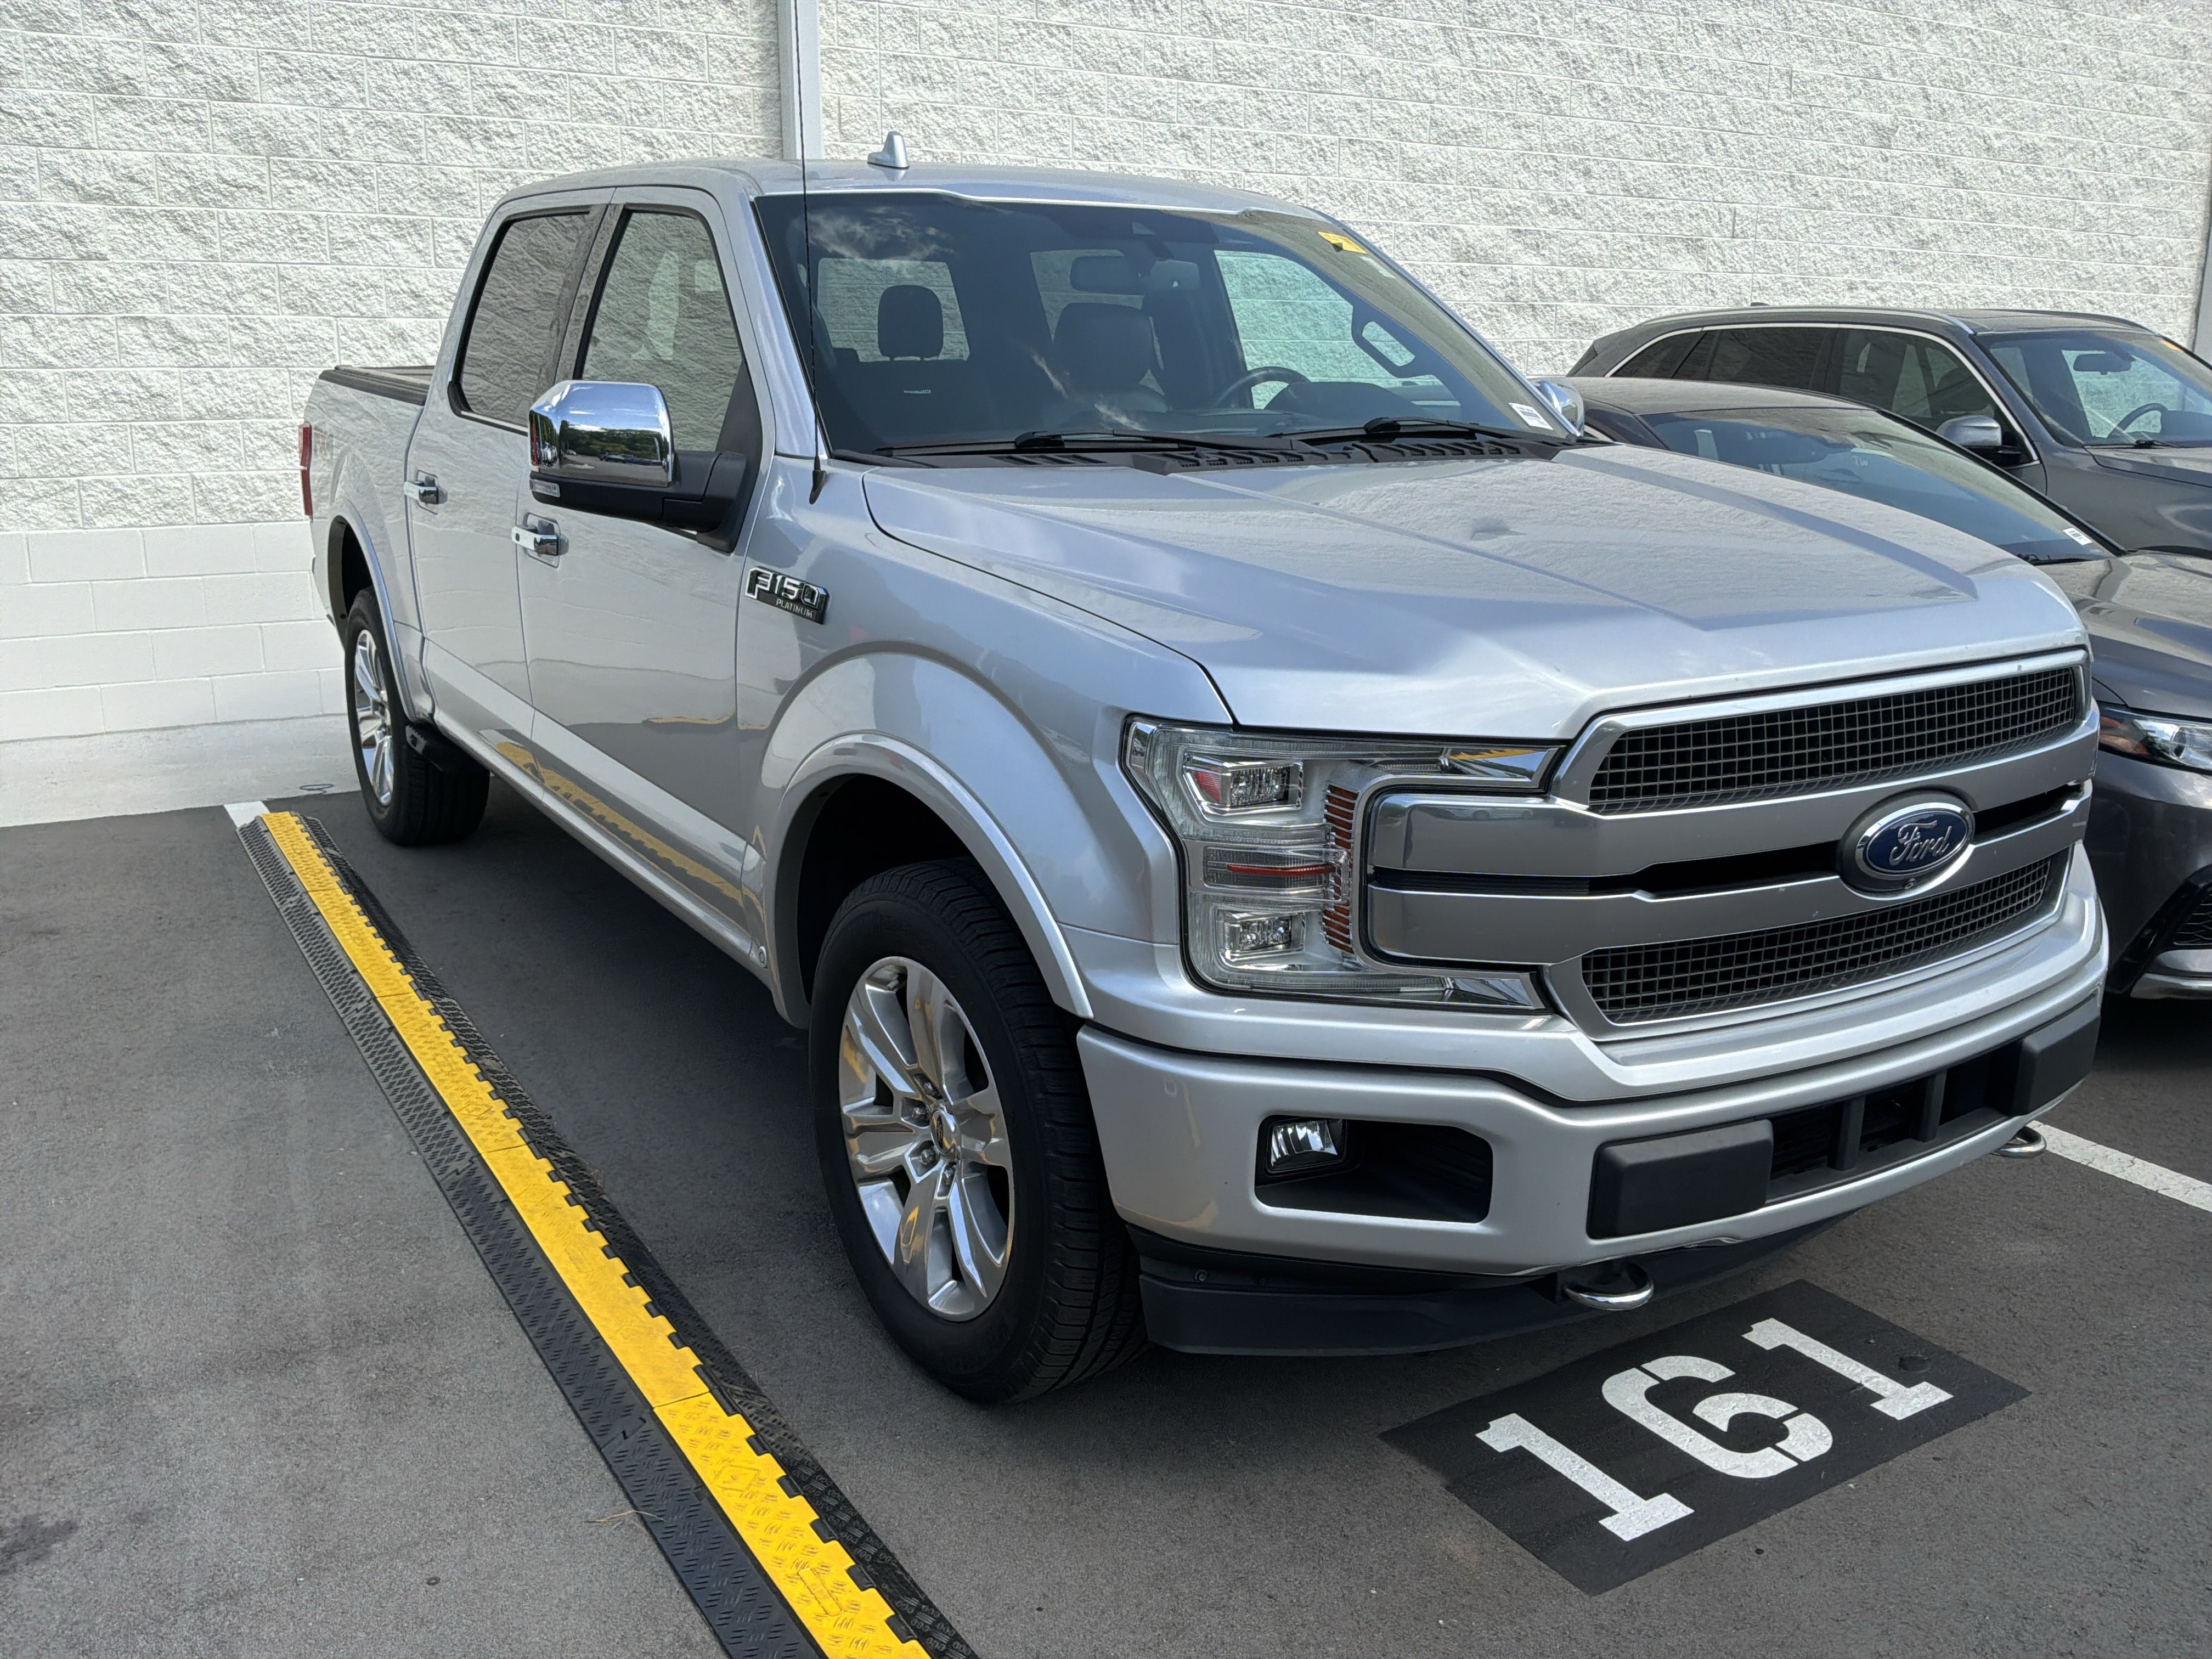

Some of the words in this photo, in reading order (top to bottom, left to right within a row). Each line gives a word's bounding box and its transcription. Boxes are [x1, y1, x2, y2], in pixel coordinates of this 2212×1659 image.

[745, 567, 826, 611] F150
[776, 598, 814, 619] PLATINUM
[1888, 820, 1953, 866] Ford
[1475, 1317, 1954, 1541] 161
